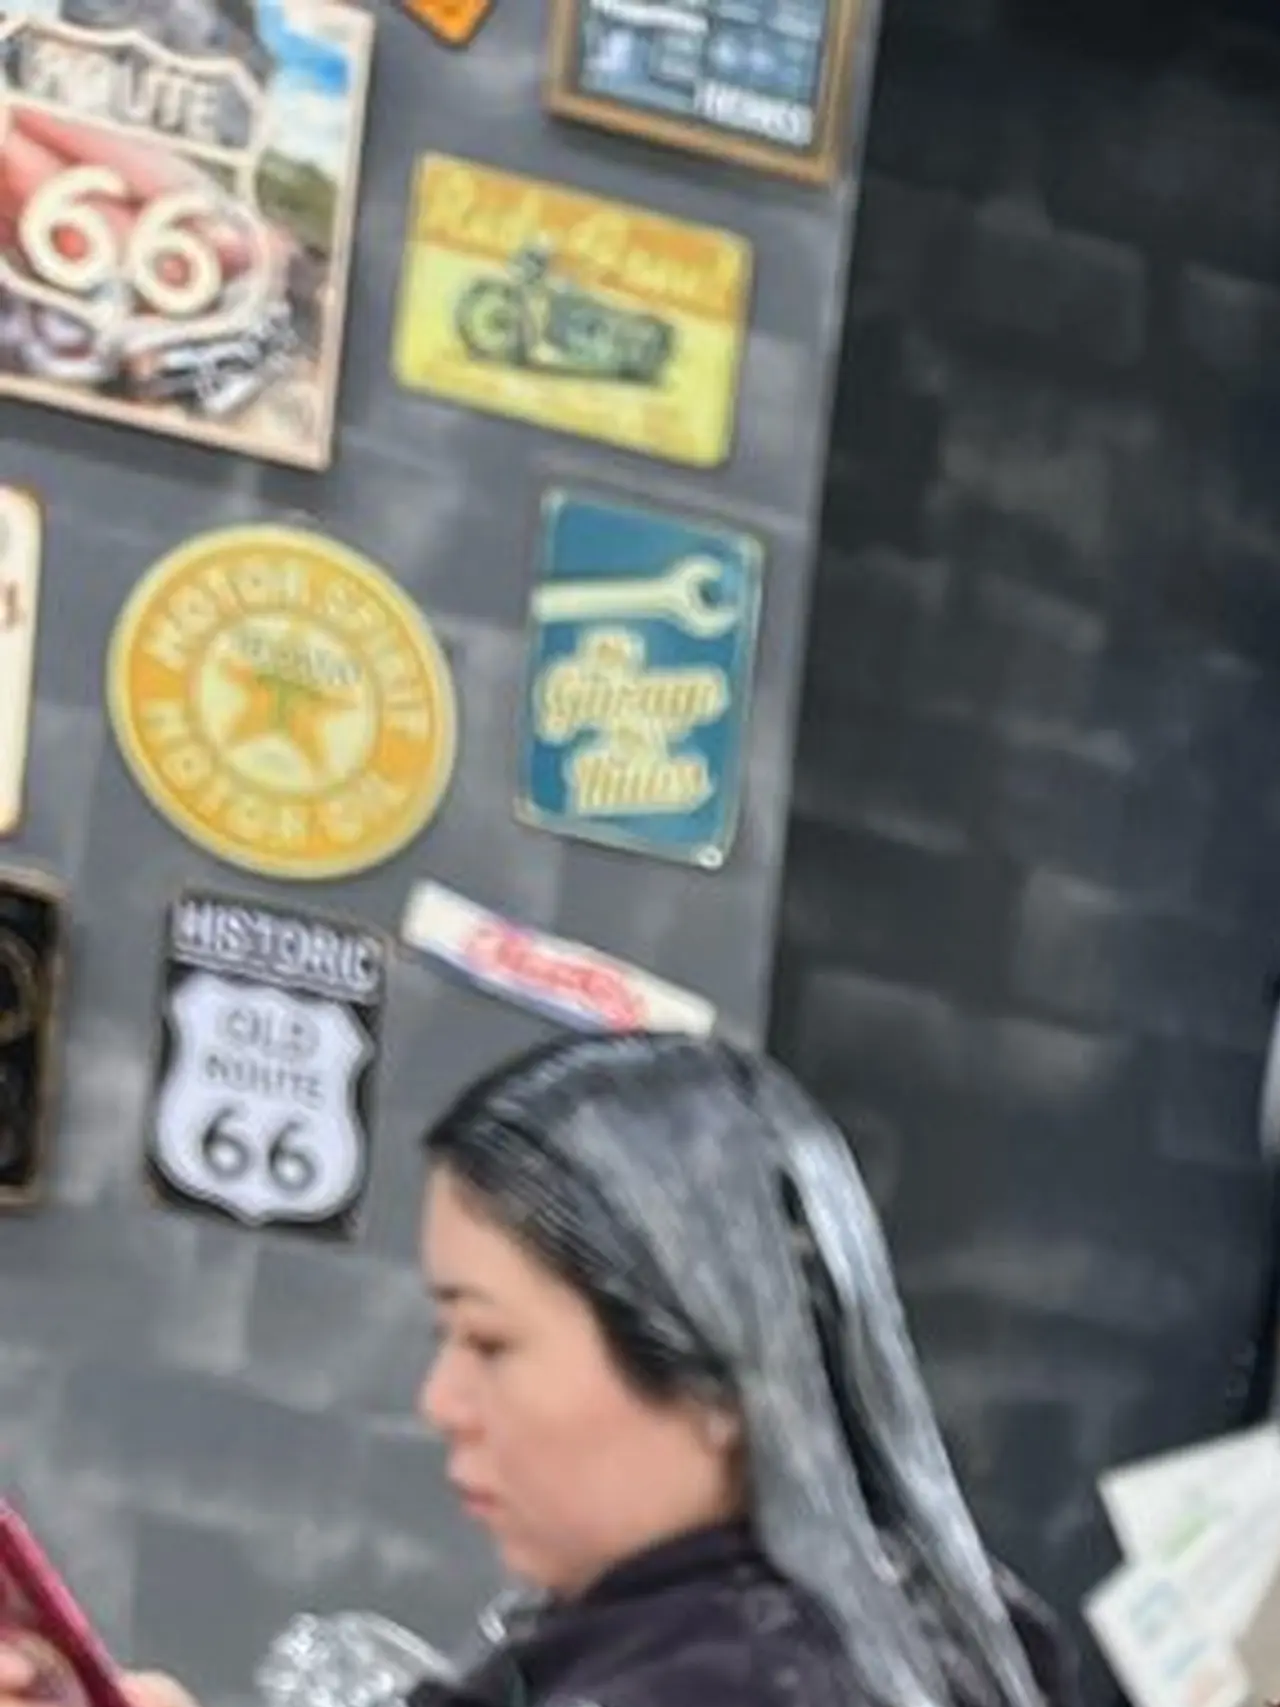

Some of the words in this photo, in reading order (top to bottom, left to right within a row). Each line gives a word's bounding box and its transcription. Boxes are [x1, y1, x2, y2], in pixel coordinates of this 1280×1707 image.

[18, 164, 223, 314] 66
[171, 898, 381, 993] HISTORIC
[224, 1006, 322, 1059] OLD
[200, 1106, 318, 1194] 66
